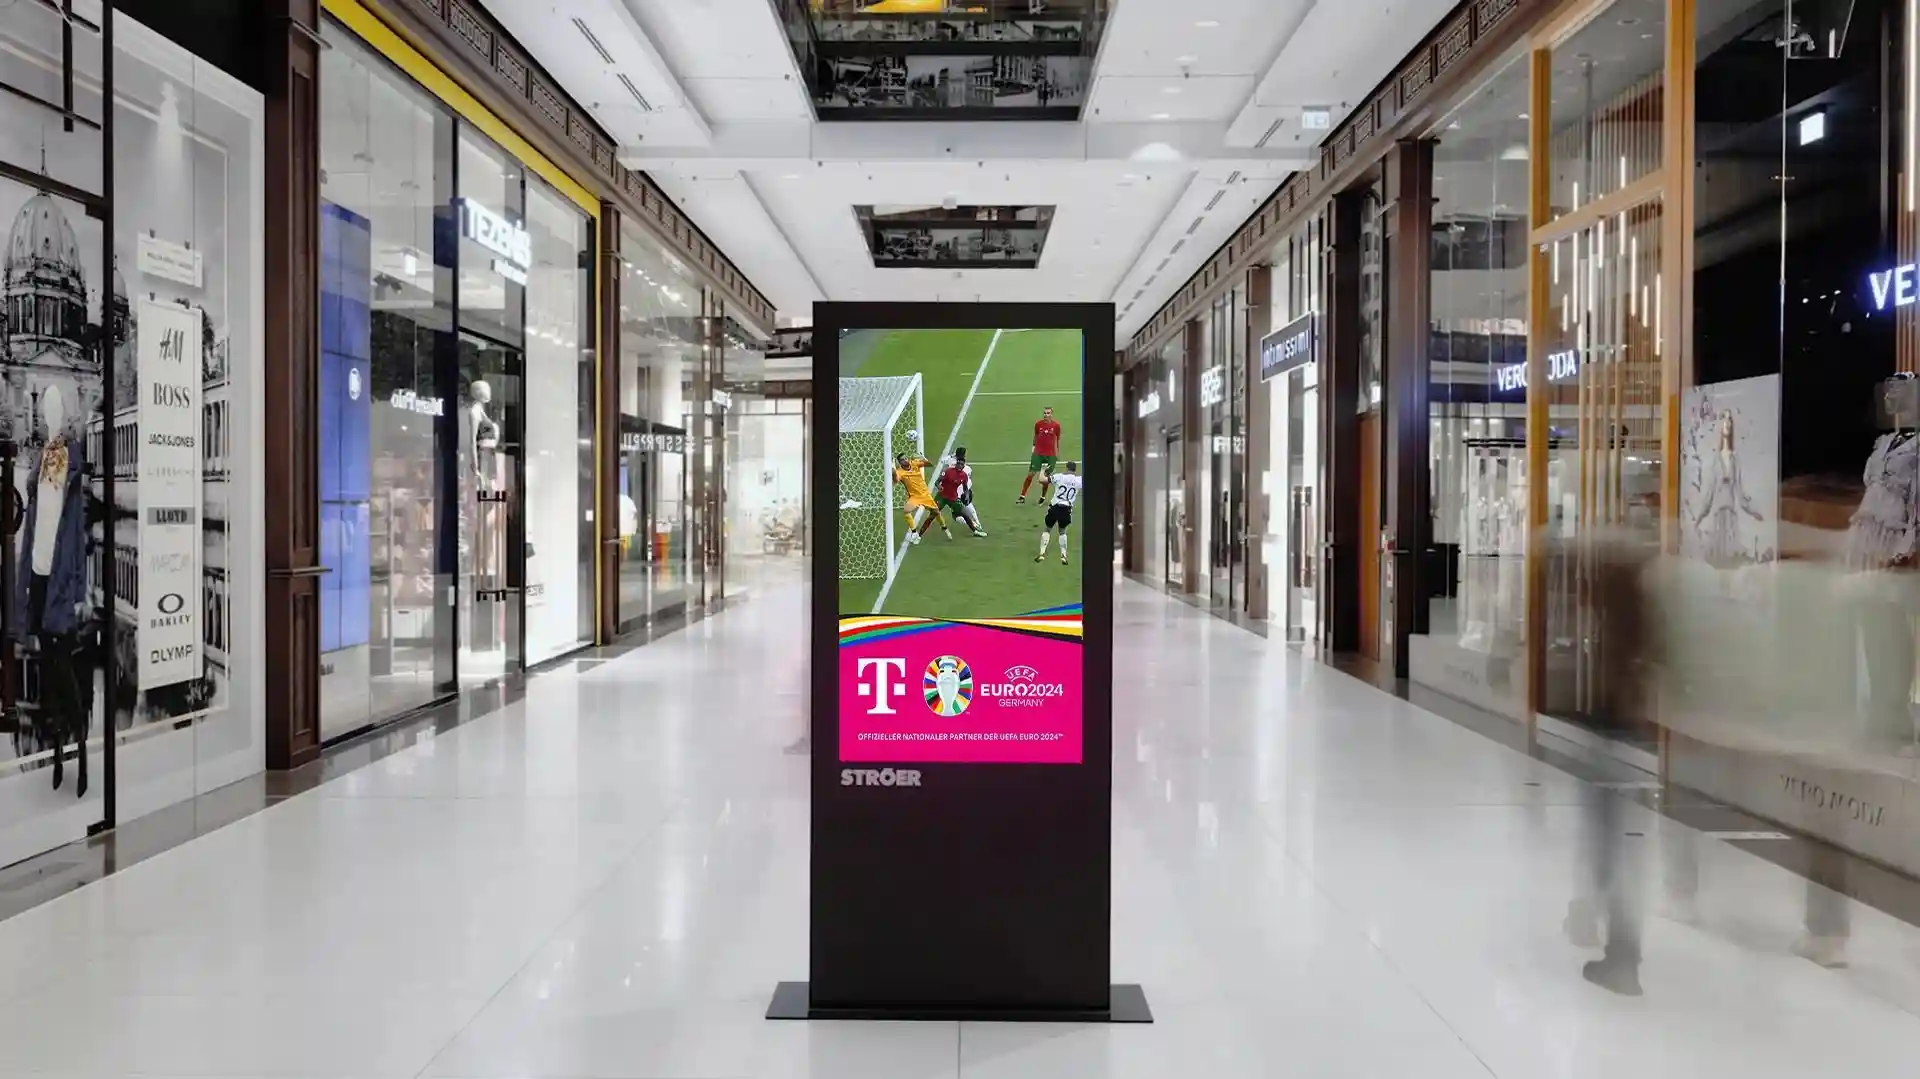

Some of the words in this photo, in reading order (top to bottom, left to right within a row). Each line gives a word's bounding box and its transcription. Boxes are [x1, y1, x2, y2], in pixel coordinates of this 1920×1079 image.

[1869, 264, 1920, 310] VE
[154, 382, 190, 408] BOSS
[1057, 485, 1077, 502] 20
[157, 509, 187, 523] LLOYD
[151, 644, 193, 664] OLYMP
[1007, 667, 1036, 680] UEFA
[999, 699, 1044, 707] GERMANY
[857, 733, 902, 741] OFFIZIELLER
[903, 733, 948, 741] NATIONALER
[949, 733, 983, 741] PARTNER
[984, 733, 999, 741] DER
[1000, 733, 1018, 741] UEFA
[1019, 733, 1040, 741] EURO
